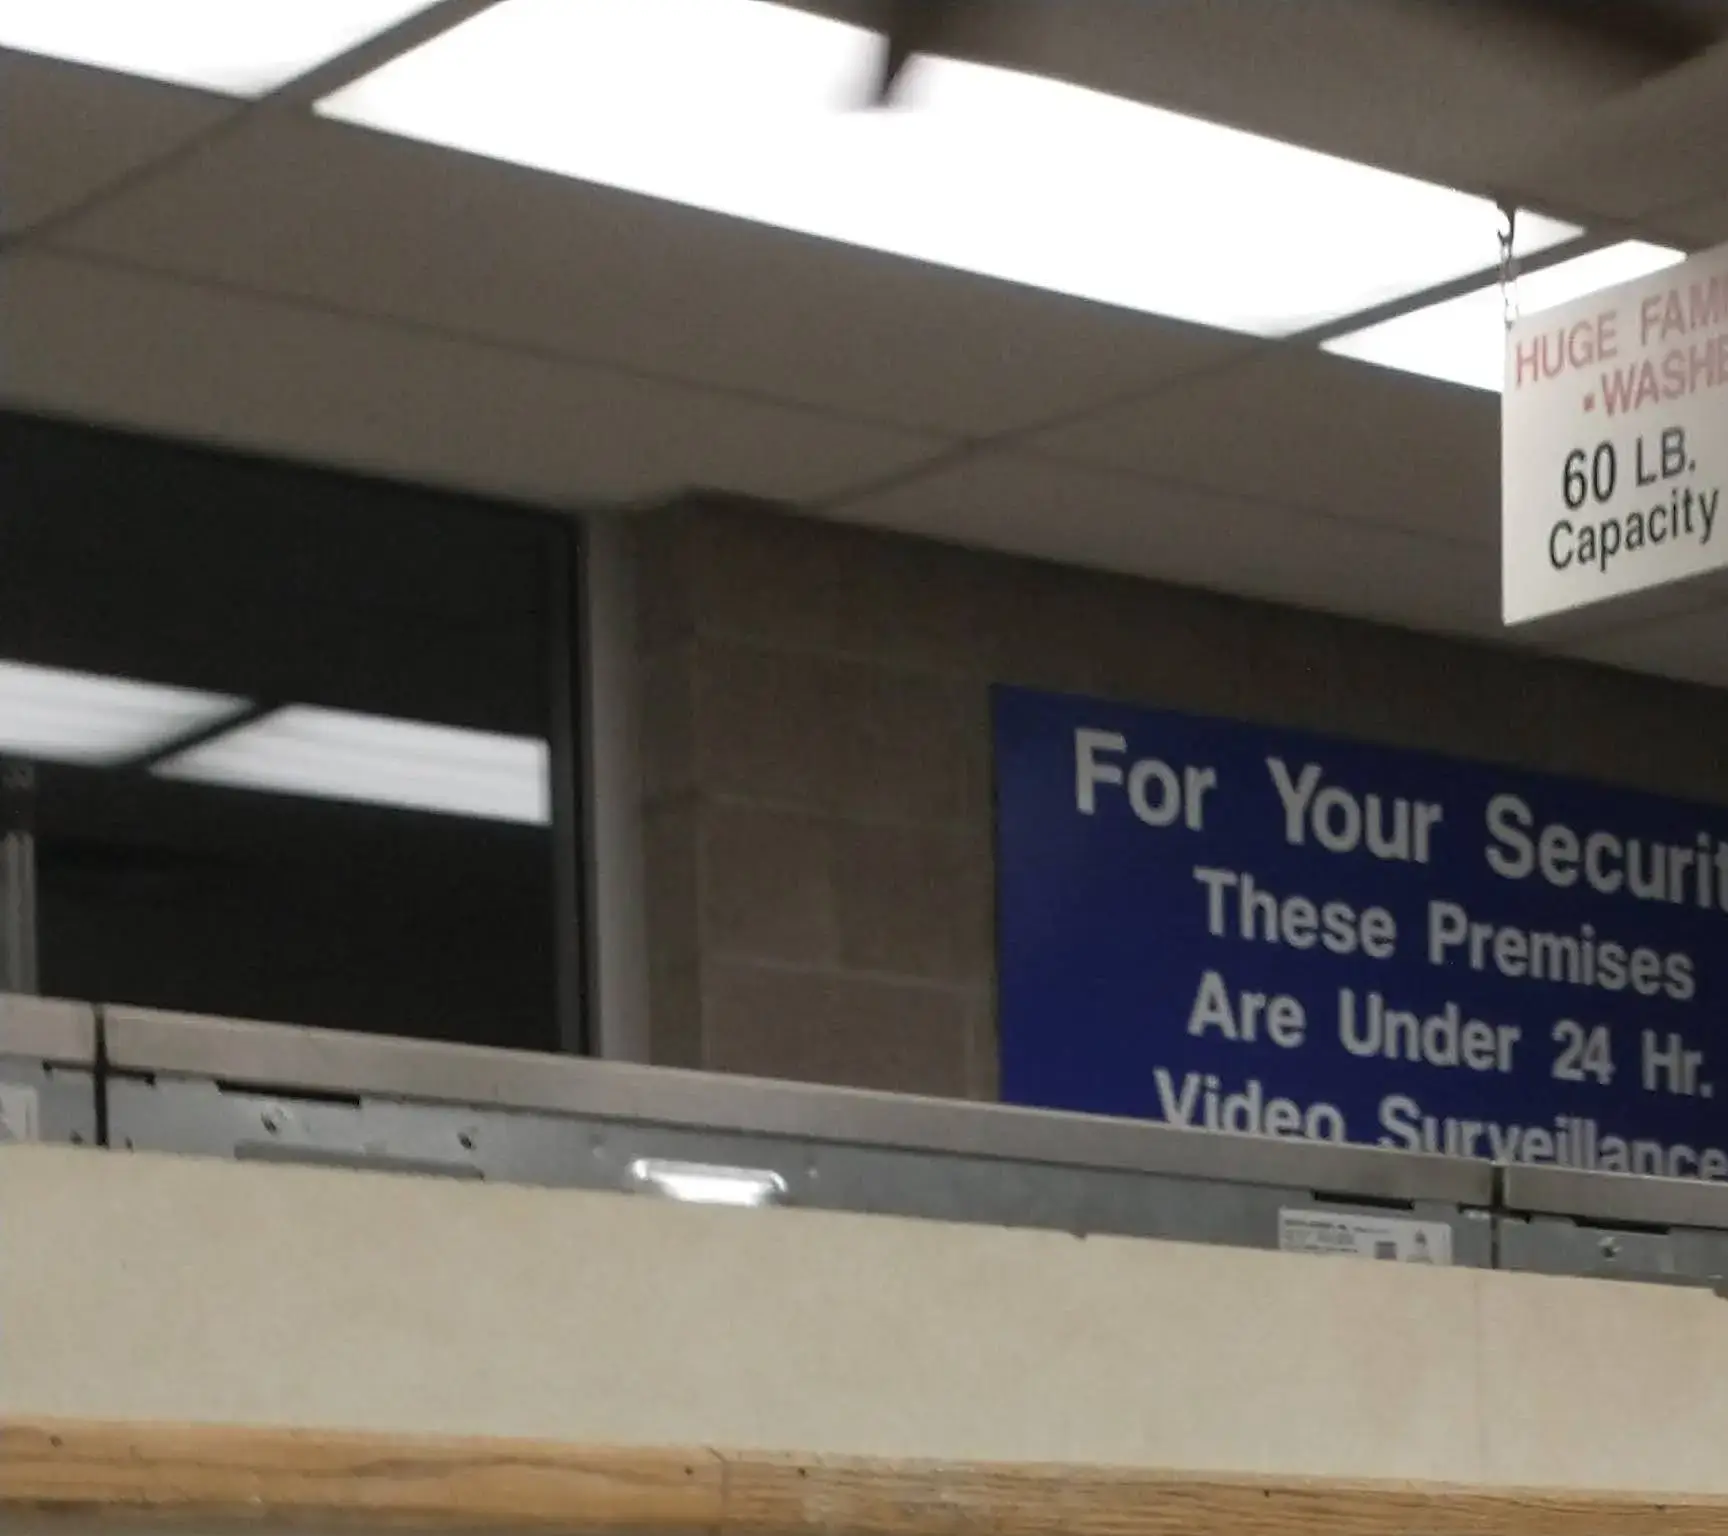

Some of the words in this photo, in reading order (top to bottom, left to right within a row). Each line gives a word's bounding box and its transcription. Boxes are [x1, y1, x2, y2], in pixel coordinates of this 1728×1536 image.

[1513, 310, 1618, 389] HUGE
[1561, 441, 1617, 511] 60
[1634, 425, 1697, 488] LB.
[1548, 487, 1720, 573] Capacity
[1074, 727, 1218, 831] For
[1265, 755, 1443, 863] Your
[1192, 865, 1397, 959] These
[1428, 899, 1696, 1001] Premises
[1187, 969, 1306, 1049] Are
[1338, 987, 1522, 1074] Under
[1551, 1019, 1616, 1086] 24
[1642, 1029, 1714, 1099] Hr.
[1152, 1065, 1347, 1144] Video
